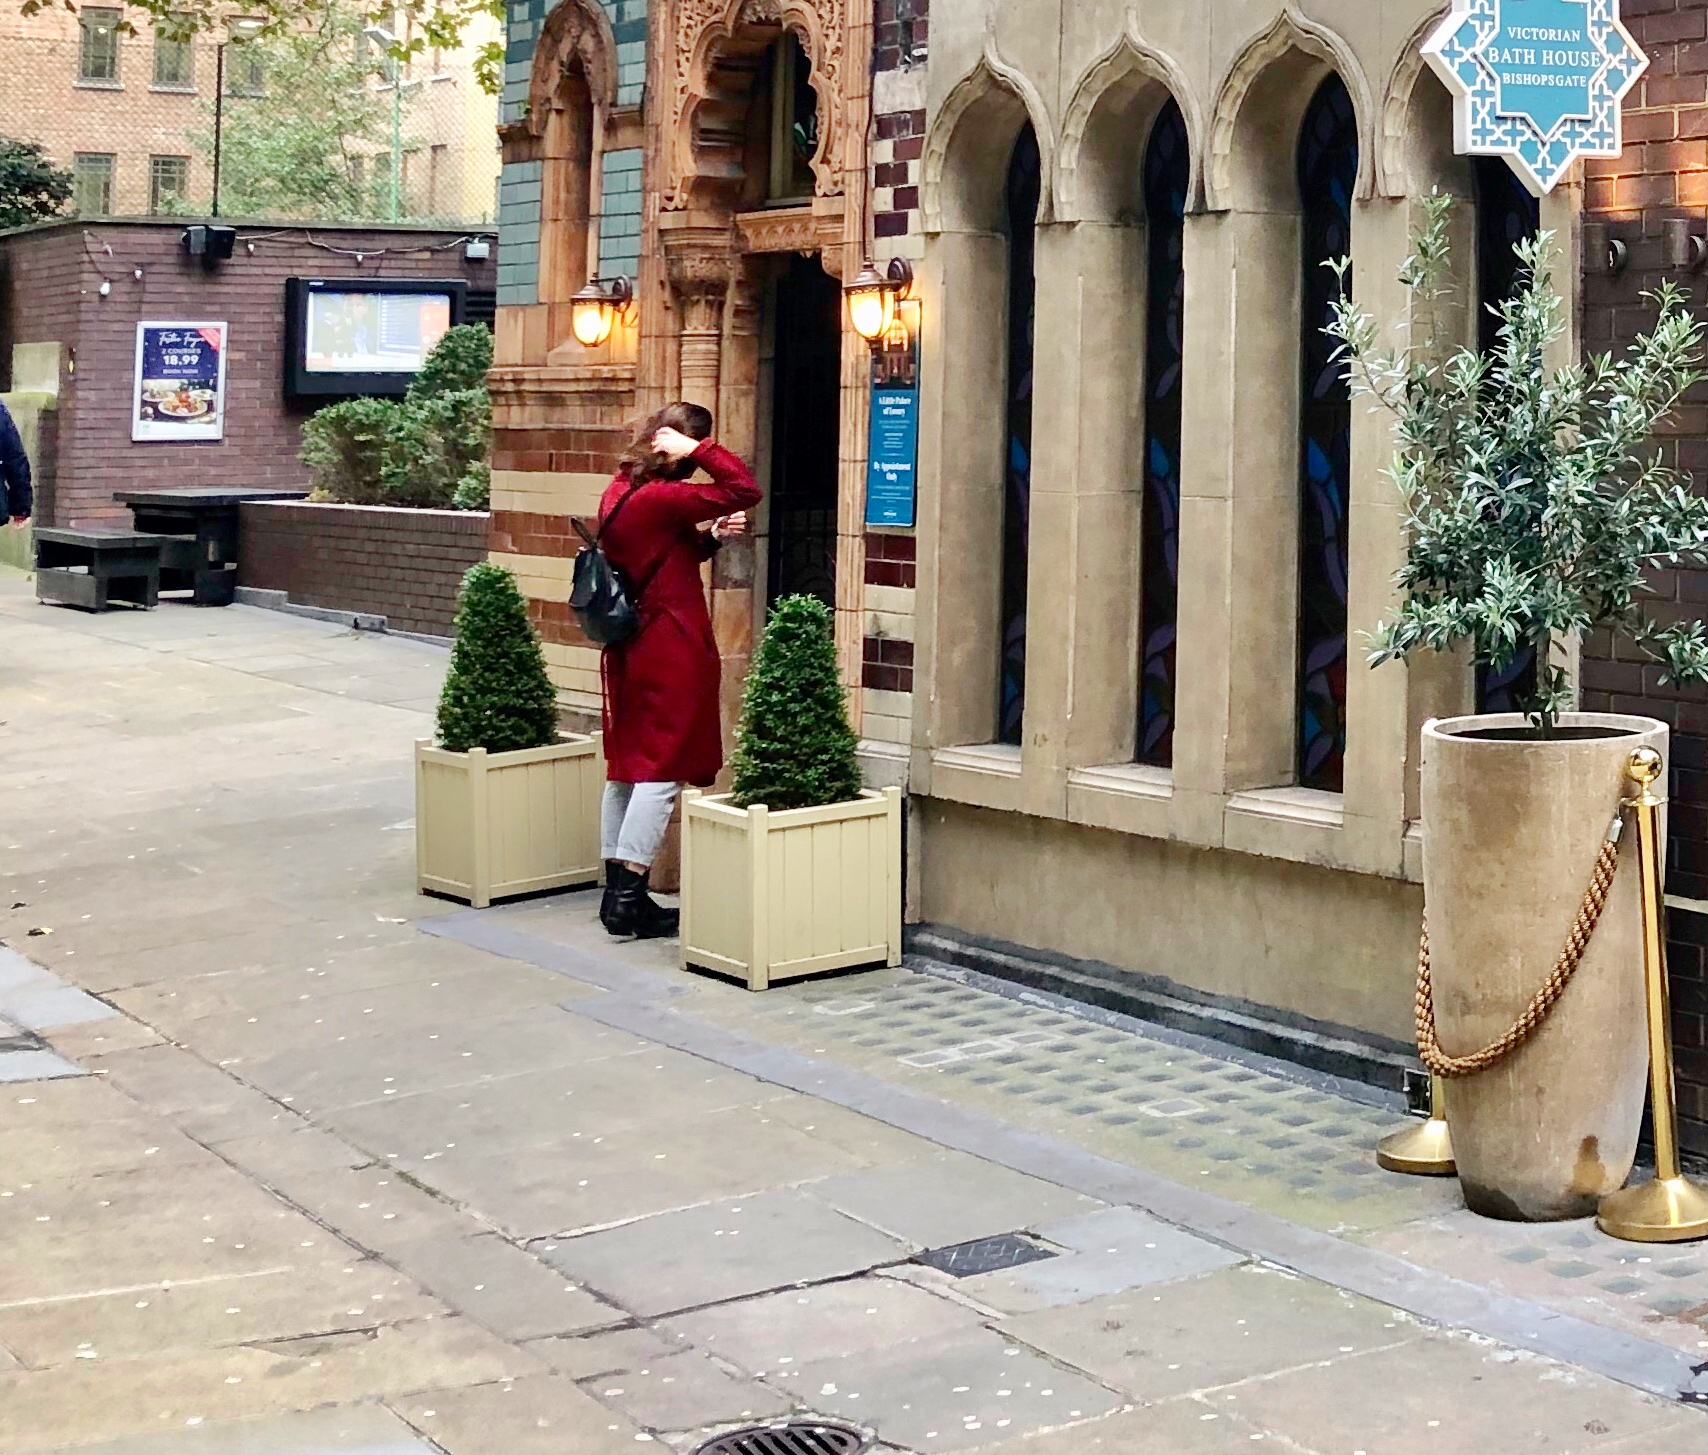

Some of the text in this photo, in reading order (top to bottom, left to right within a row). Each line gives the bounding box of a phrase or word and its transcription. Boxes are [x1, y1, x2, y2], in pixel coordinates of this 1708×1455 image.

[1507, 26, 1581, 42] VICTORIAN
[1488, 47, 1601, 68] BATH HOUSE
[1502, 72, 1587, 87] BISHOPSGATE
[163, 354, 200, 365] 18.99
